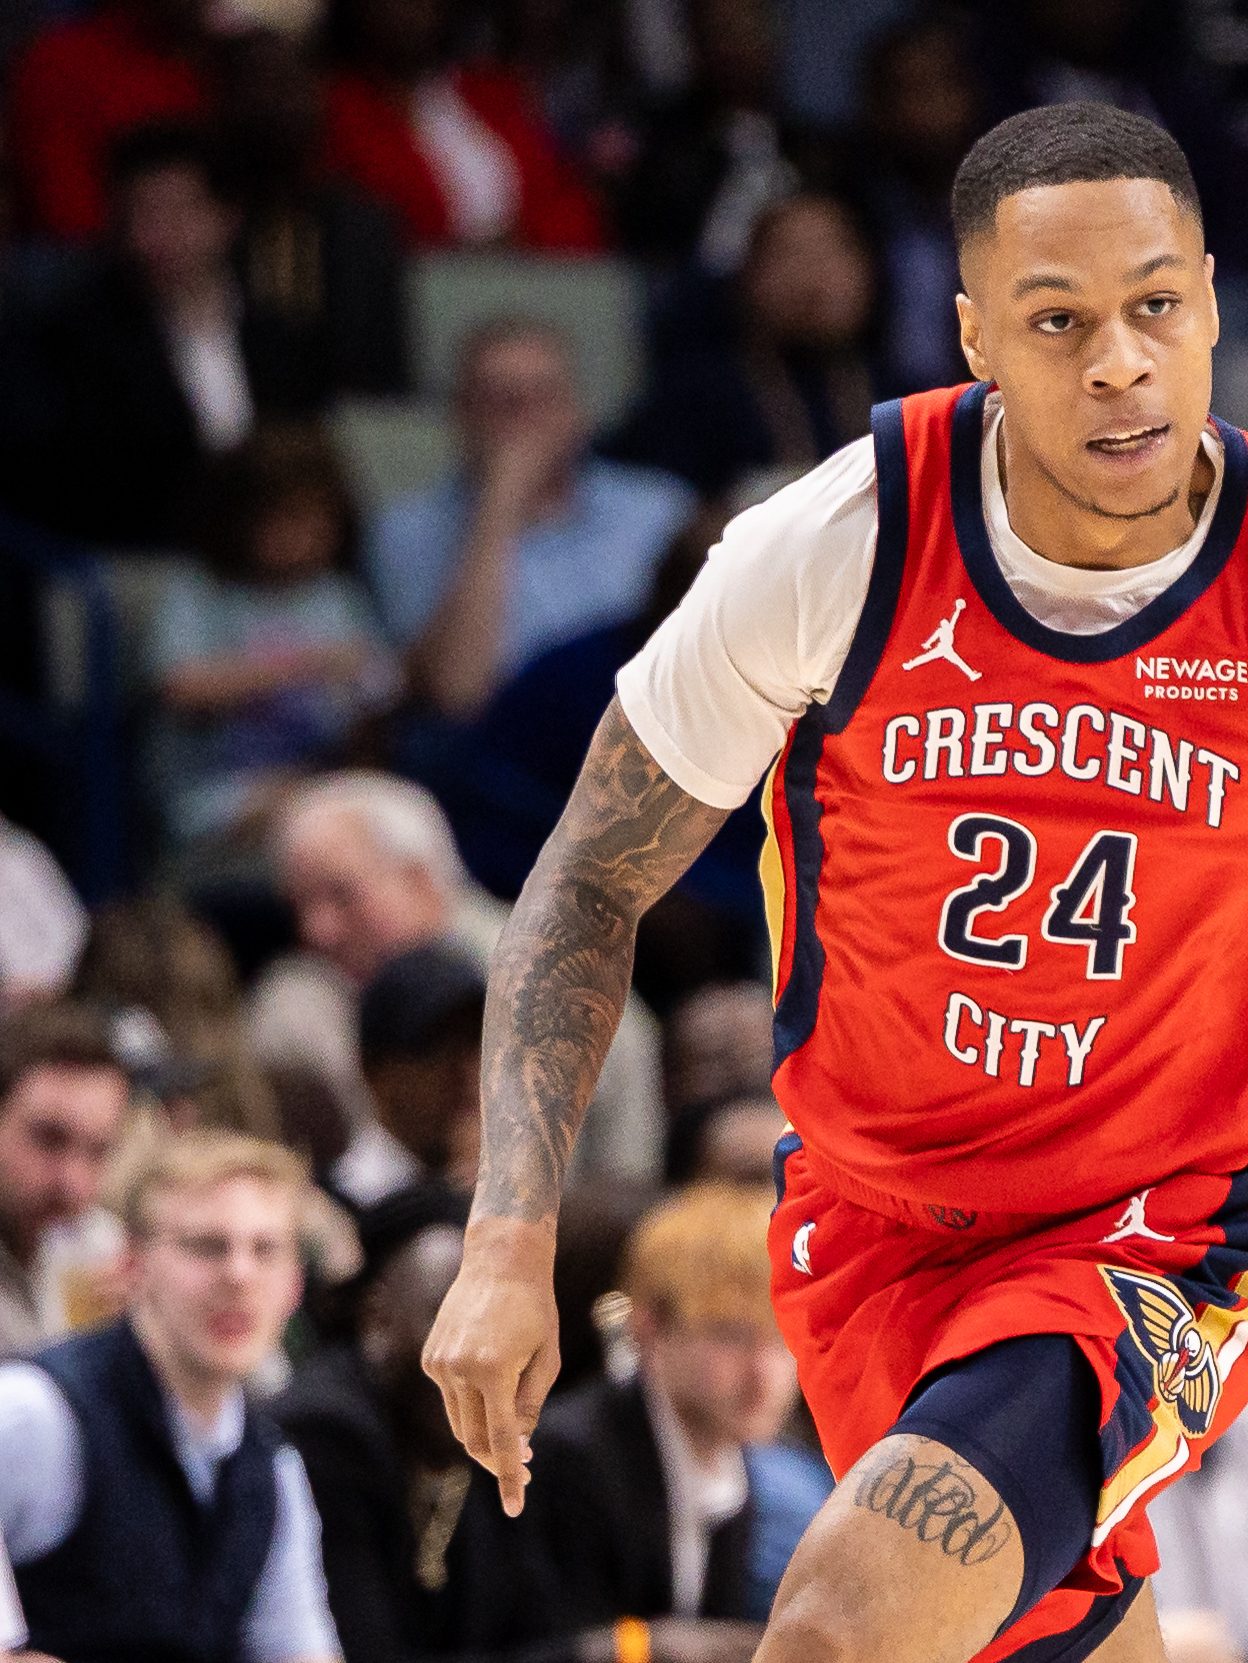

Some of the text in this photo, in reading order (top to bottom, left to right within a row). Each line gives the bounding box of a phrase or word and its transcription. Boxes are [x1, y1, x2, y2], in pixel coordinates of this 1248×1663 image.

[1136, 656, 1248, 684] NEWAGE
[1144, 684, 1239, 701] PRODUCTS
[882, 702, 1239, 828] CRESCENT
[937, 811, 1139, 980] 24
[942, 991, 1107, 1088] CITY
